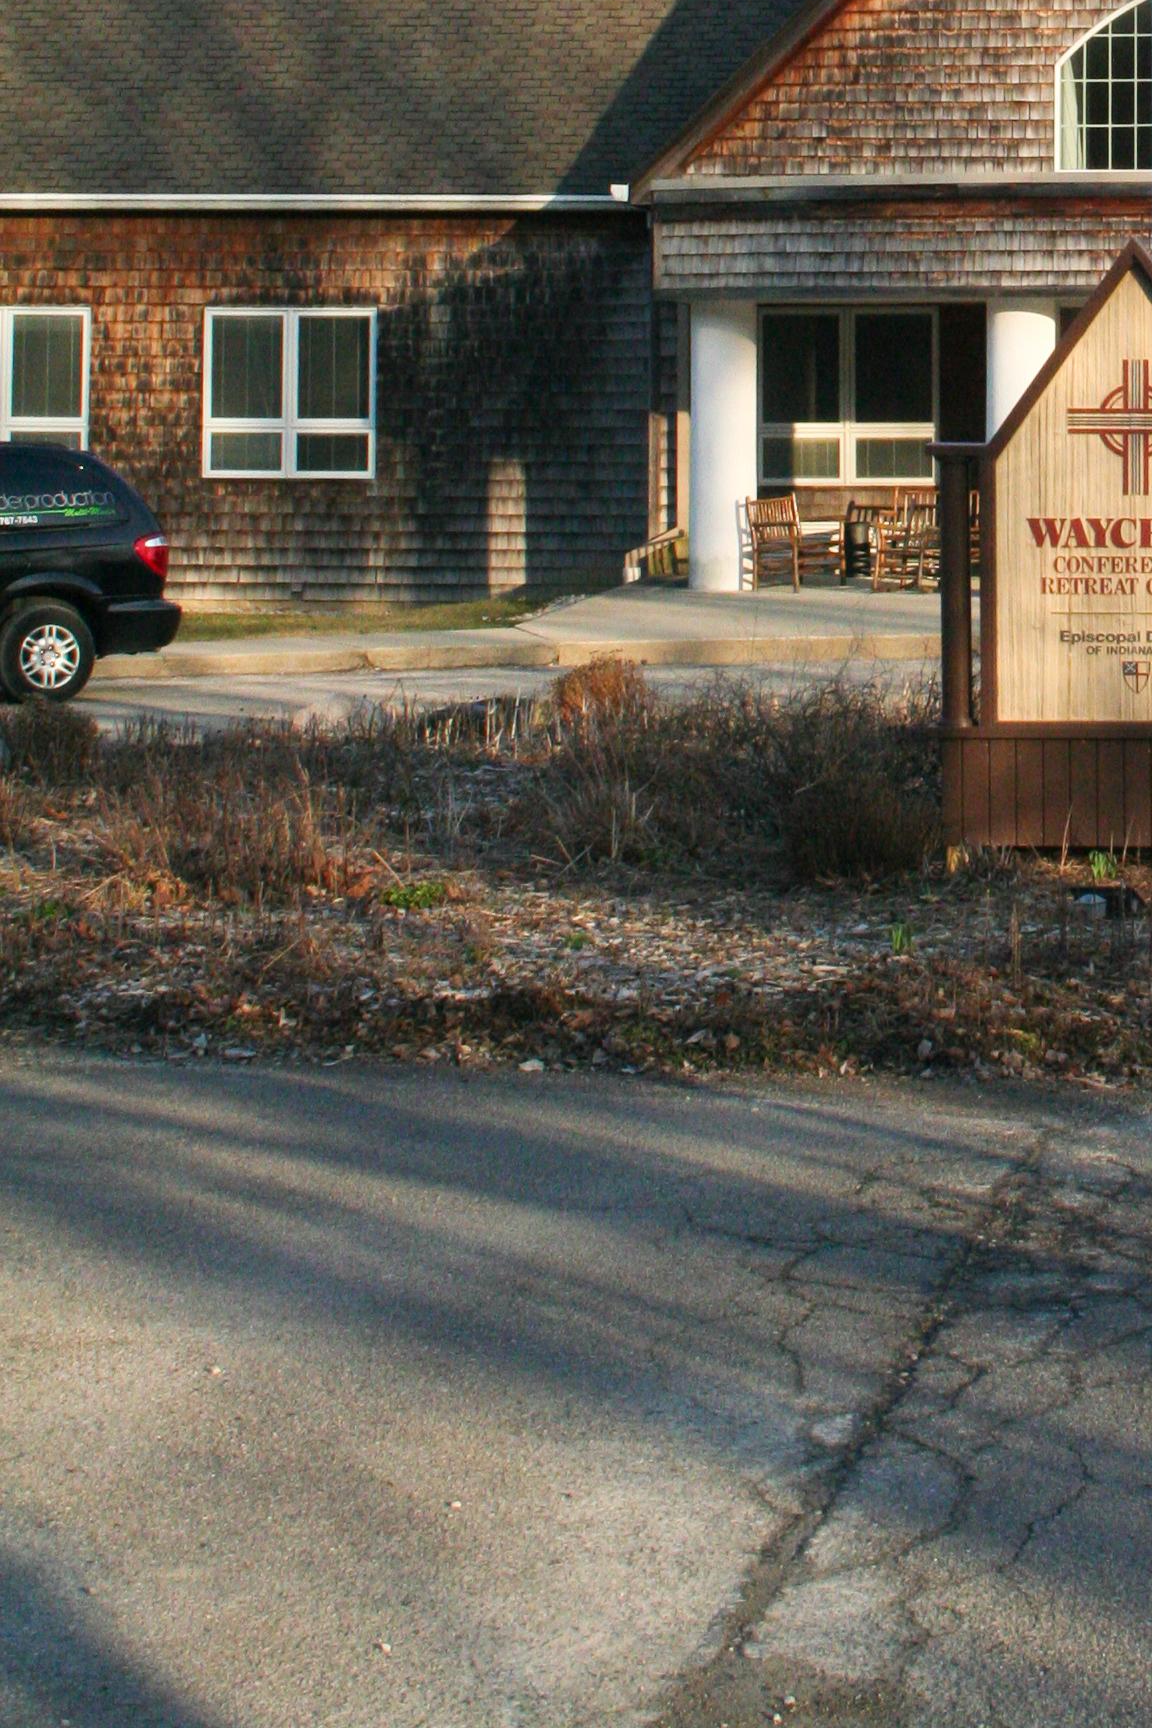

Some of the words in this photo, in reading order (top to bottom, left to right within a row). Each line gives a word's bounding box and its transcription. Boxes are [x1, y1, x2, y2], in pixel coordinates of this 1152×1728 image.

[1041, 577, 1139, 595] RETREAT
[1060, 630, 1140, 644] Episcopal
[1086, 646, 1101, 655] OF
